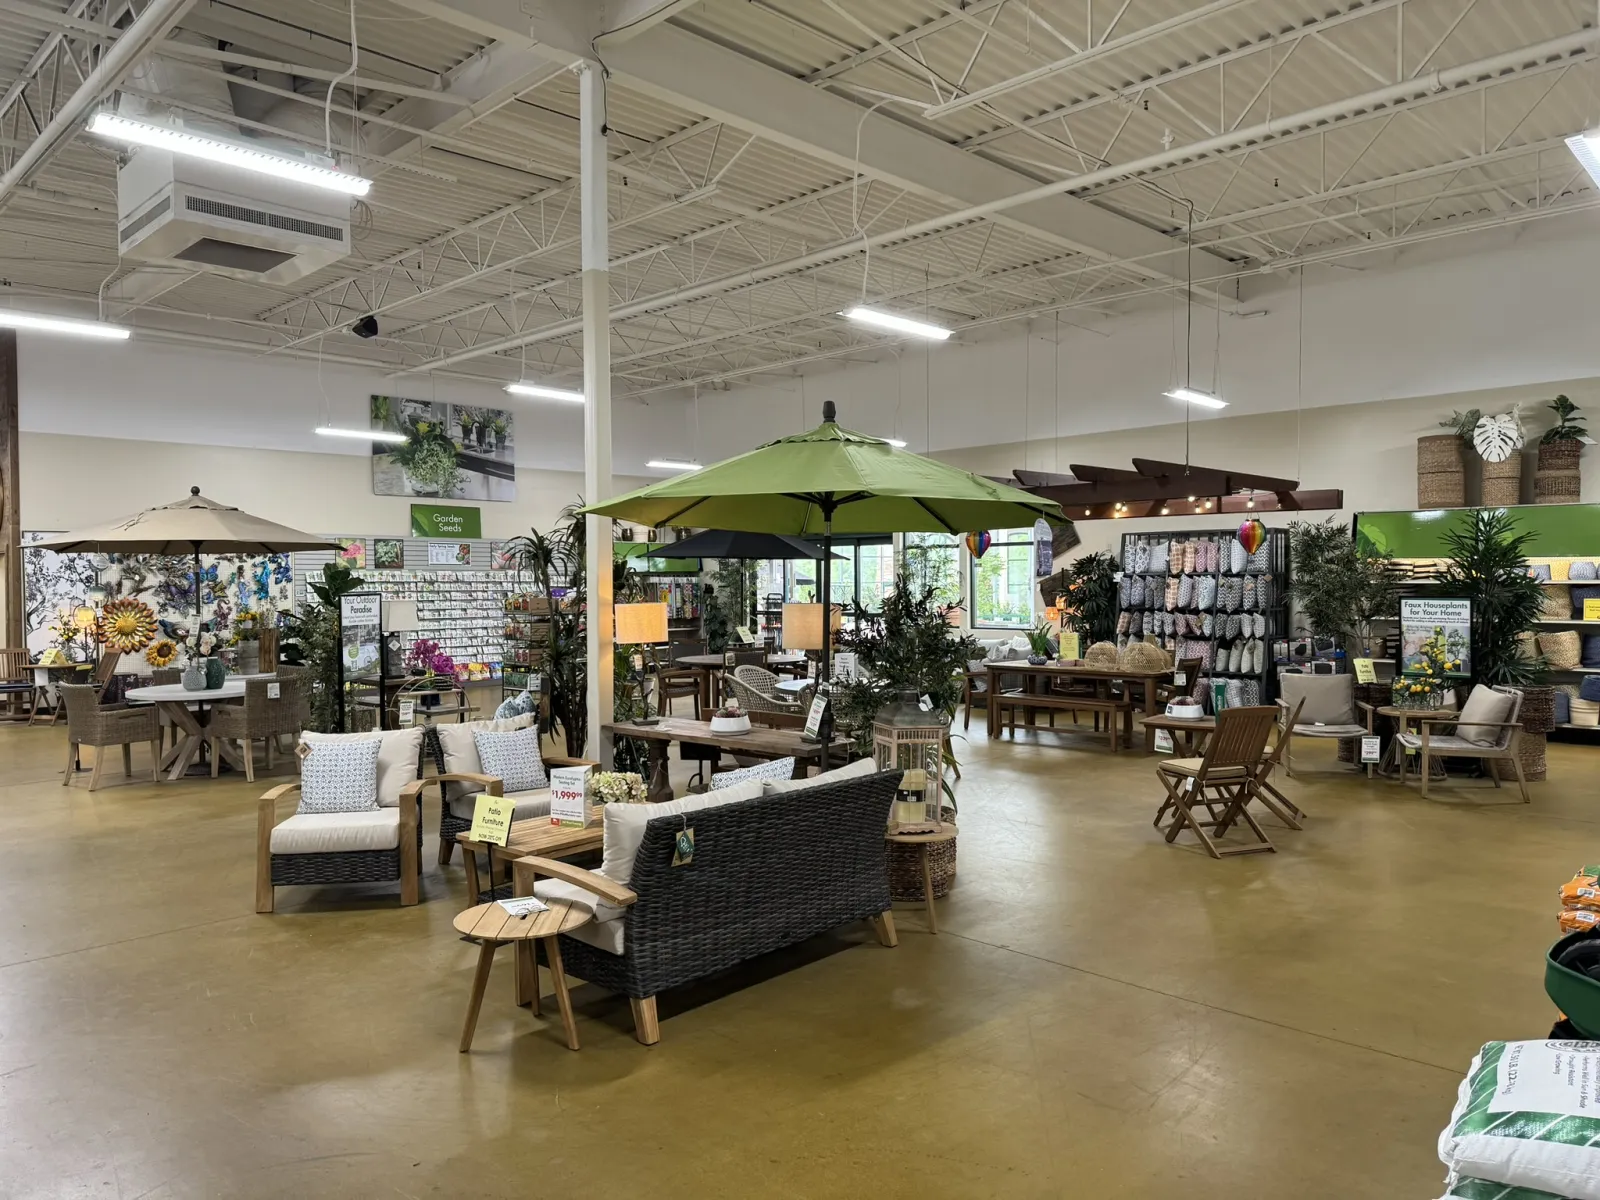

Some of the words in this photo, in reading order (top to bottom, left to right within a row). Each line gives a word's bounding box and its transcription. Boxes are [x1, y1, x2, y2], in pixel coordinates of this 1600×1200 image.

[433, 513, 463, 523] Garden
[438, 523, 462, 533] Seeds
[344, 596, 355, 605] Your
[356, 596, 377, 604] Outdoor
[350, 605, 372, 614] Paradise
[1423, 602, 1468, 610] Houseplants
[488, 807, 502, 816] Patio
[481, 816, 505, 827] Furniture
[1578, 1095, 1589, 1109] Shade
